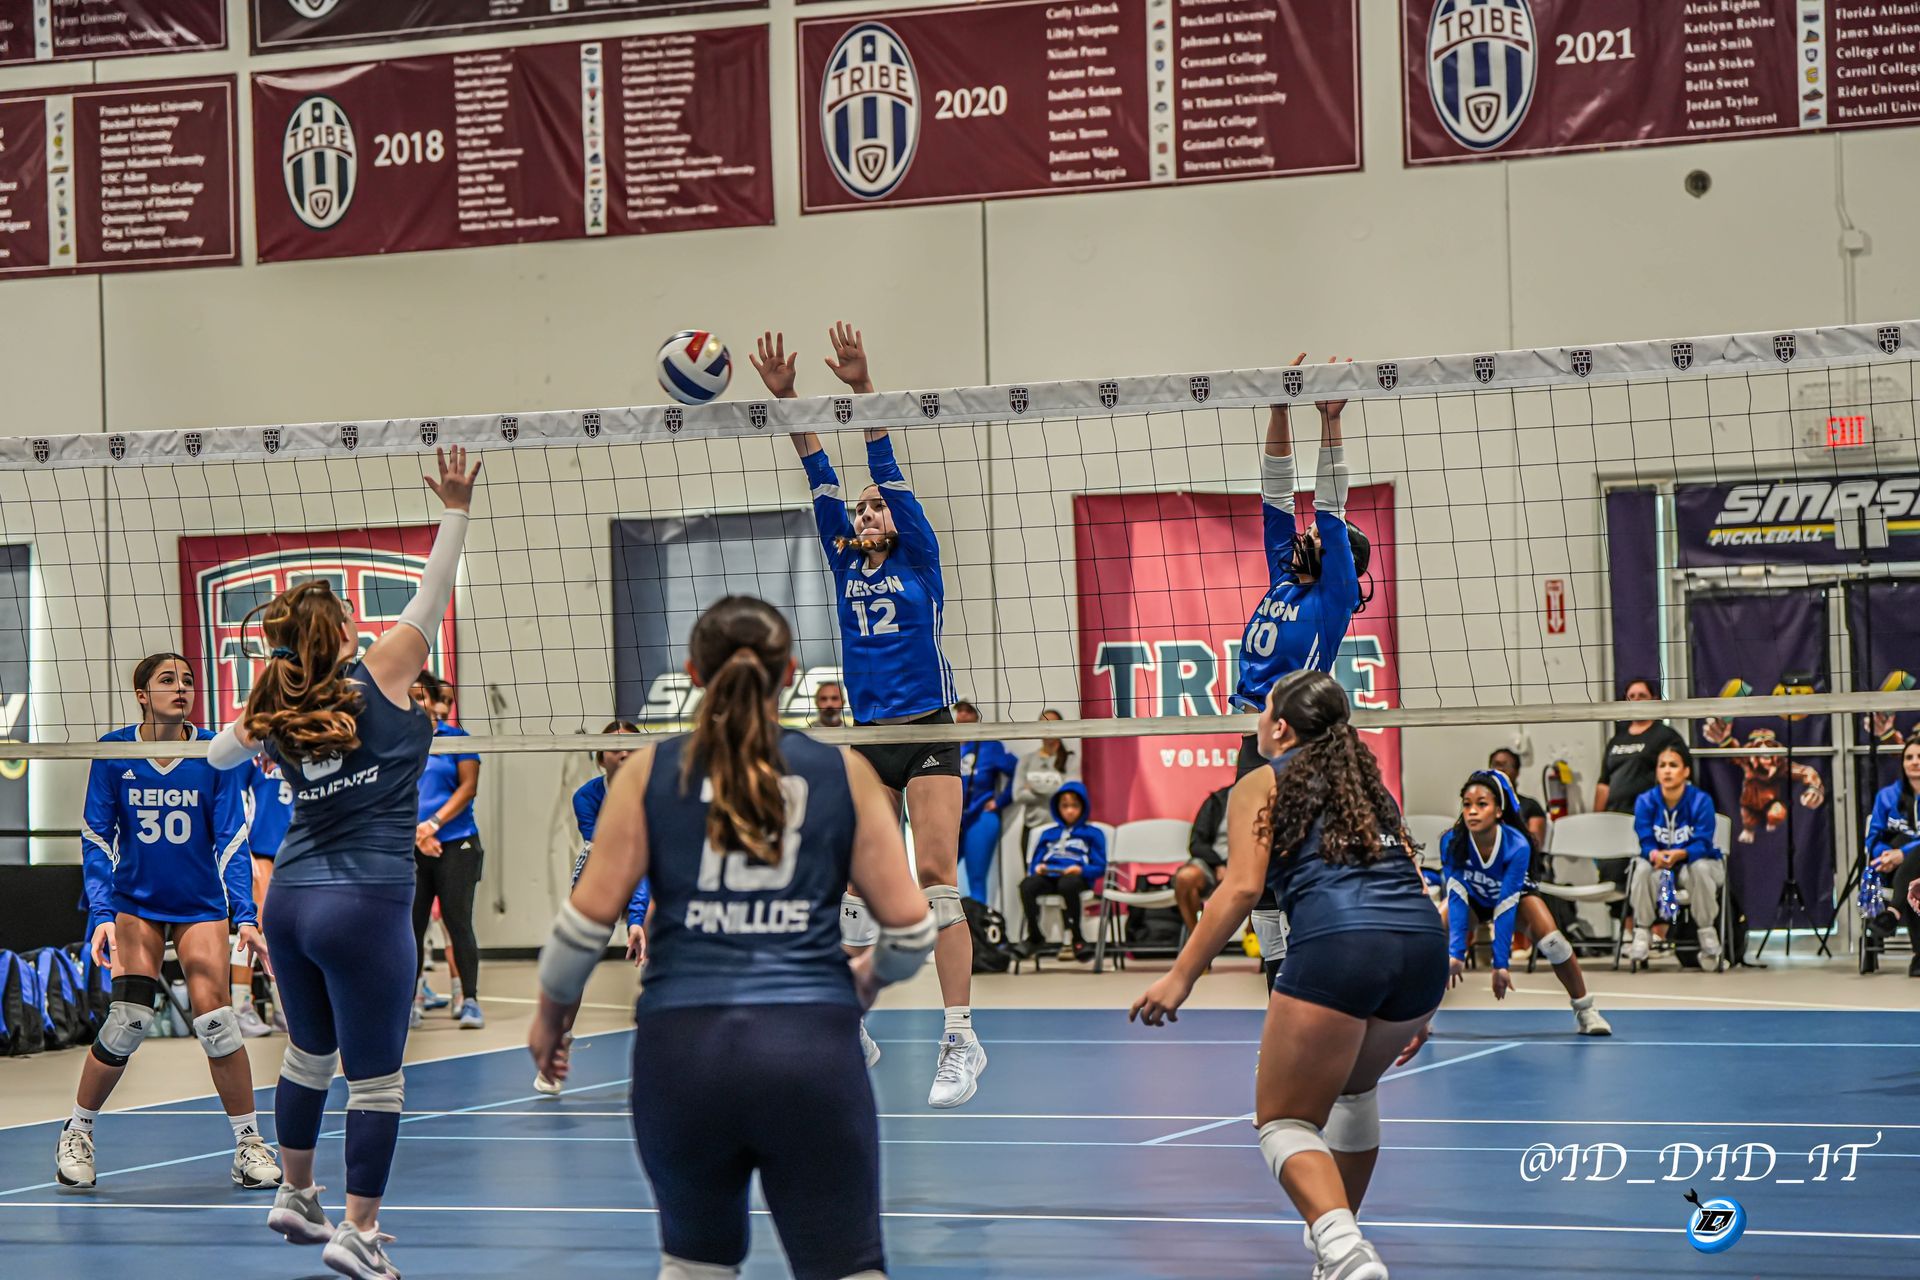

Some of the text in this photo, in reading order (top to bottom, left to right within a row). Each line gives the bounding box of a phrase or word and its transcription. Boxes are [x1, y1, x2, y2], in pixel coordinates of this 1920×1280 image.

[1684, 3, 1718, 15] Alexis
[1836, 6, 1876, 20] Florida
[1439, 8, 1524, 42] TRIBE
[1836, 28, 1869, 42] James
[1555, 27, 1635, 65] 2021
[1685, 37, 1753, 53] Annie Smith
[1836, 42, 1916, 60] College of the
[1685, 57, 1755, 73] Sarah Stokes
[1837, 64, 1876, 78] Carroll
[831, 64, 908, 96] TRIBE
[1686, 77, 1749, 92] Bella Sweet
[1838, 81, 1920, 98] Rider Universi
[934, 85, 1008, 119] 2020
[1686, 94, 1759, 114] Jordan Taylor
[1839, 102, 1887, 117] Bucknell
[1687, 116, 1731, 130] Amanda
[290, 126, 348, 148] TRIBE
[374, 129, 445, 167] 2018
[1827, 416, 1865, 447] EXIT
[1712, 527, 1823, 546] PICKLEBALL
[845, 576, 904, 598] REIGN
[852, 598, 899, 636] 12
[1246, 618, 1278, 657] 10
[128, 788, 198, 807] REIGN
[136, 810, 191, 845] 30
[685, 899, 810, 934] PINILLOS
